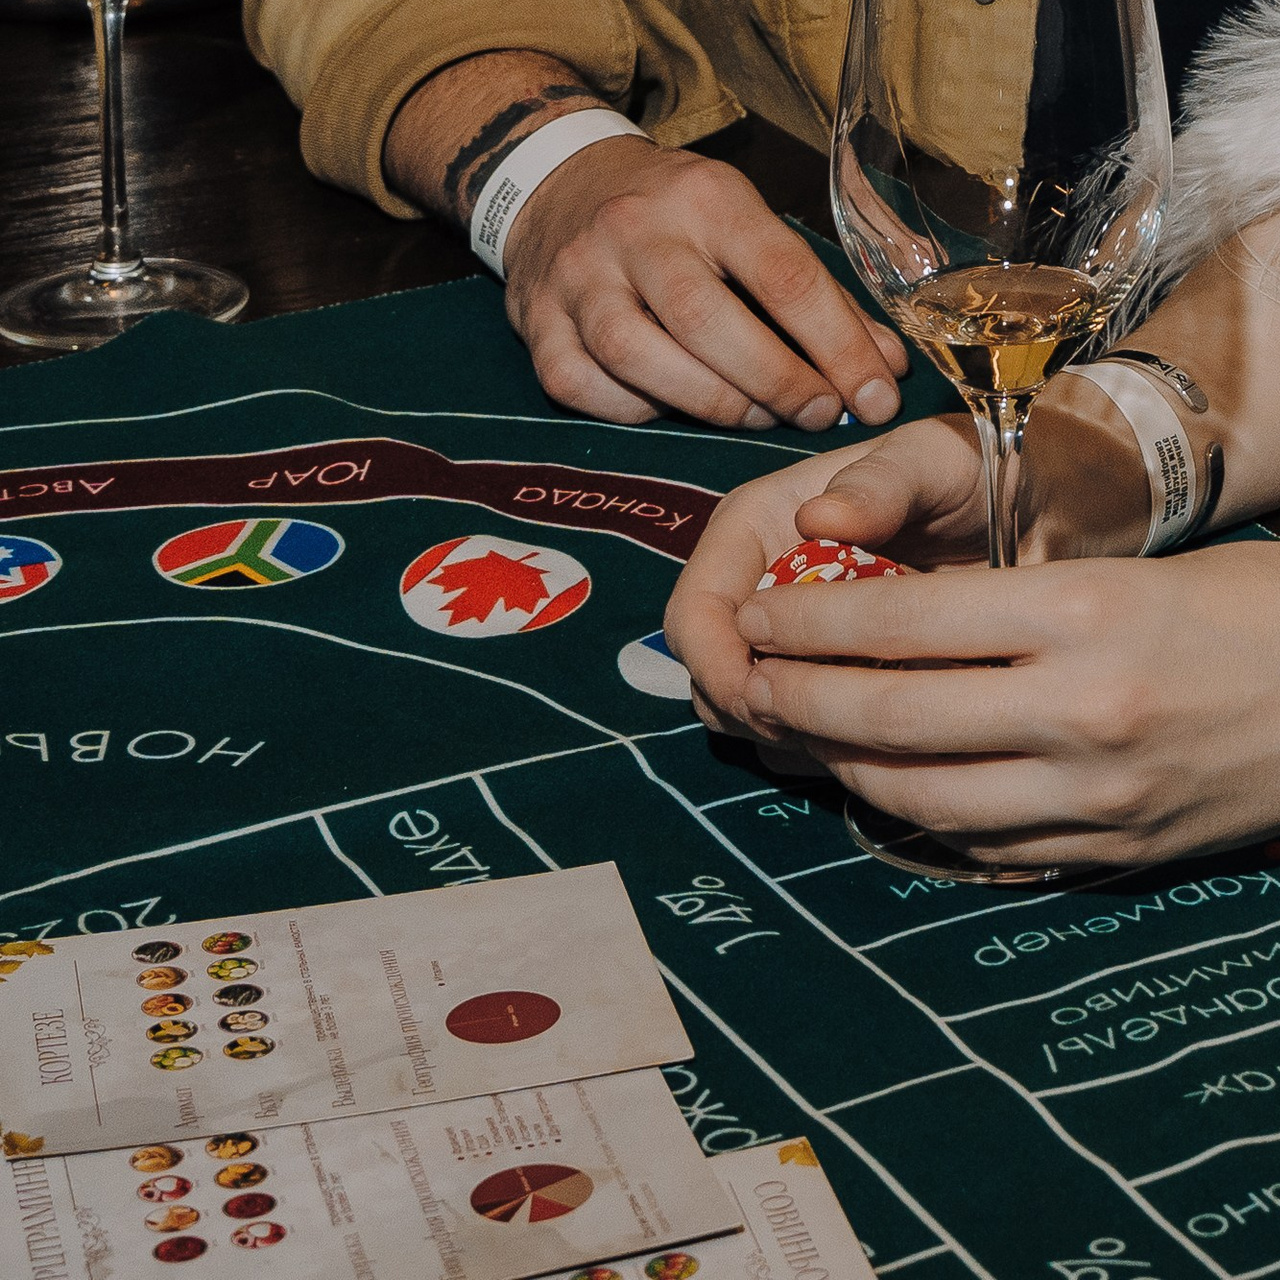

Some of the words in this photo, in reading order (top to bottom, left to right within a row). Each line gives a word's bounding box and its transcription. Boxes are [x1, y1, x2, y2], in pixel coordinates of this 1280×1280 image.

[247, 457, 373, 490] ЮАР
[1154, 440, 1172, 499] СВОБОДНЫЙ
[1162, 437, 1176, 462] ЭТИМ
[1170, 433, 1187, 473] ТОЛЬКО
[513, 483, 694, 534] Канада
[378, 948, 423, 1033] происхождения
[32, 1007, 74, 1087] КОРТЕЗЕ
[400, 1034, 437, 1096] География
[326, 1047, 356, 1109] Выдержка
[173, 1087, 205, 1129] Аромат
